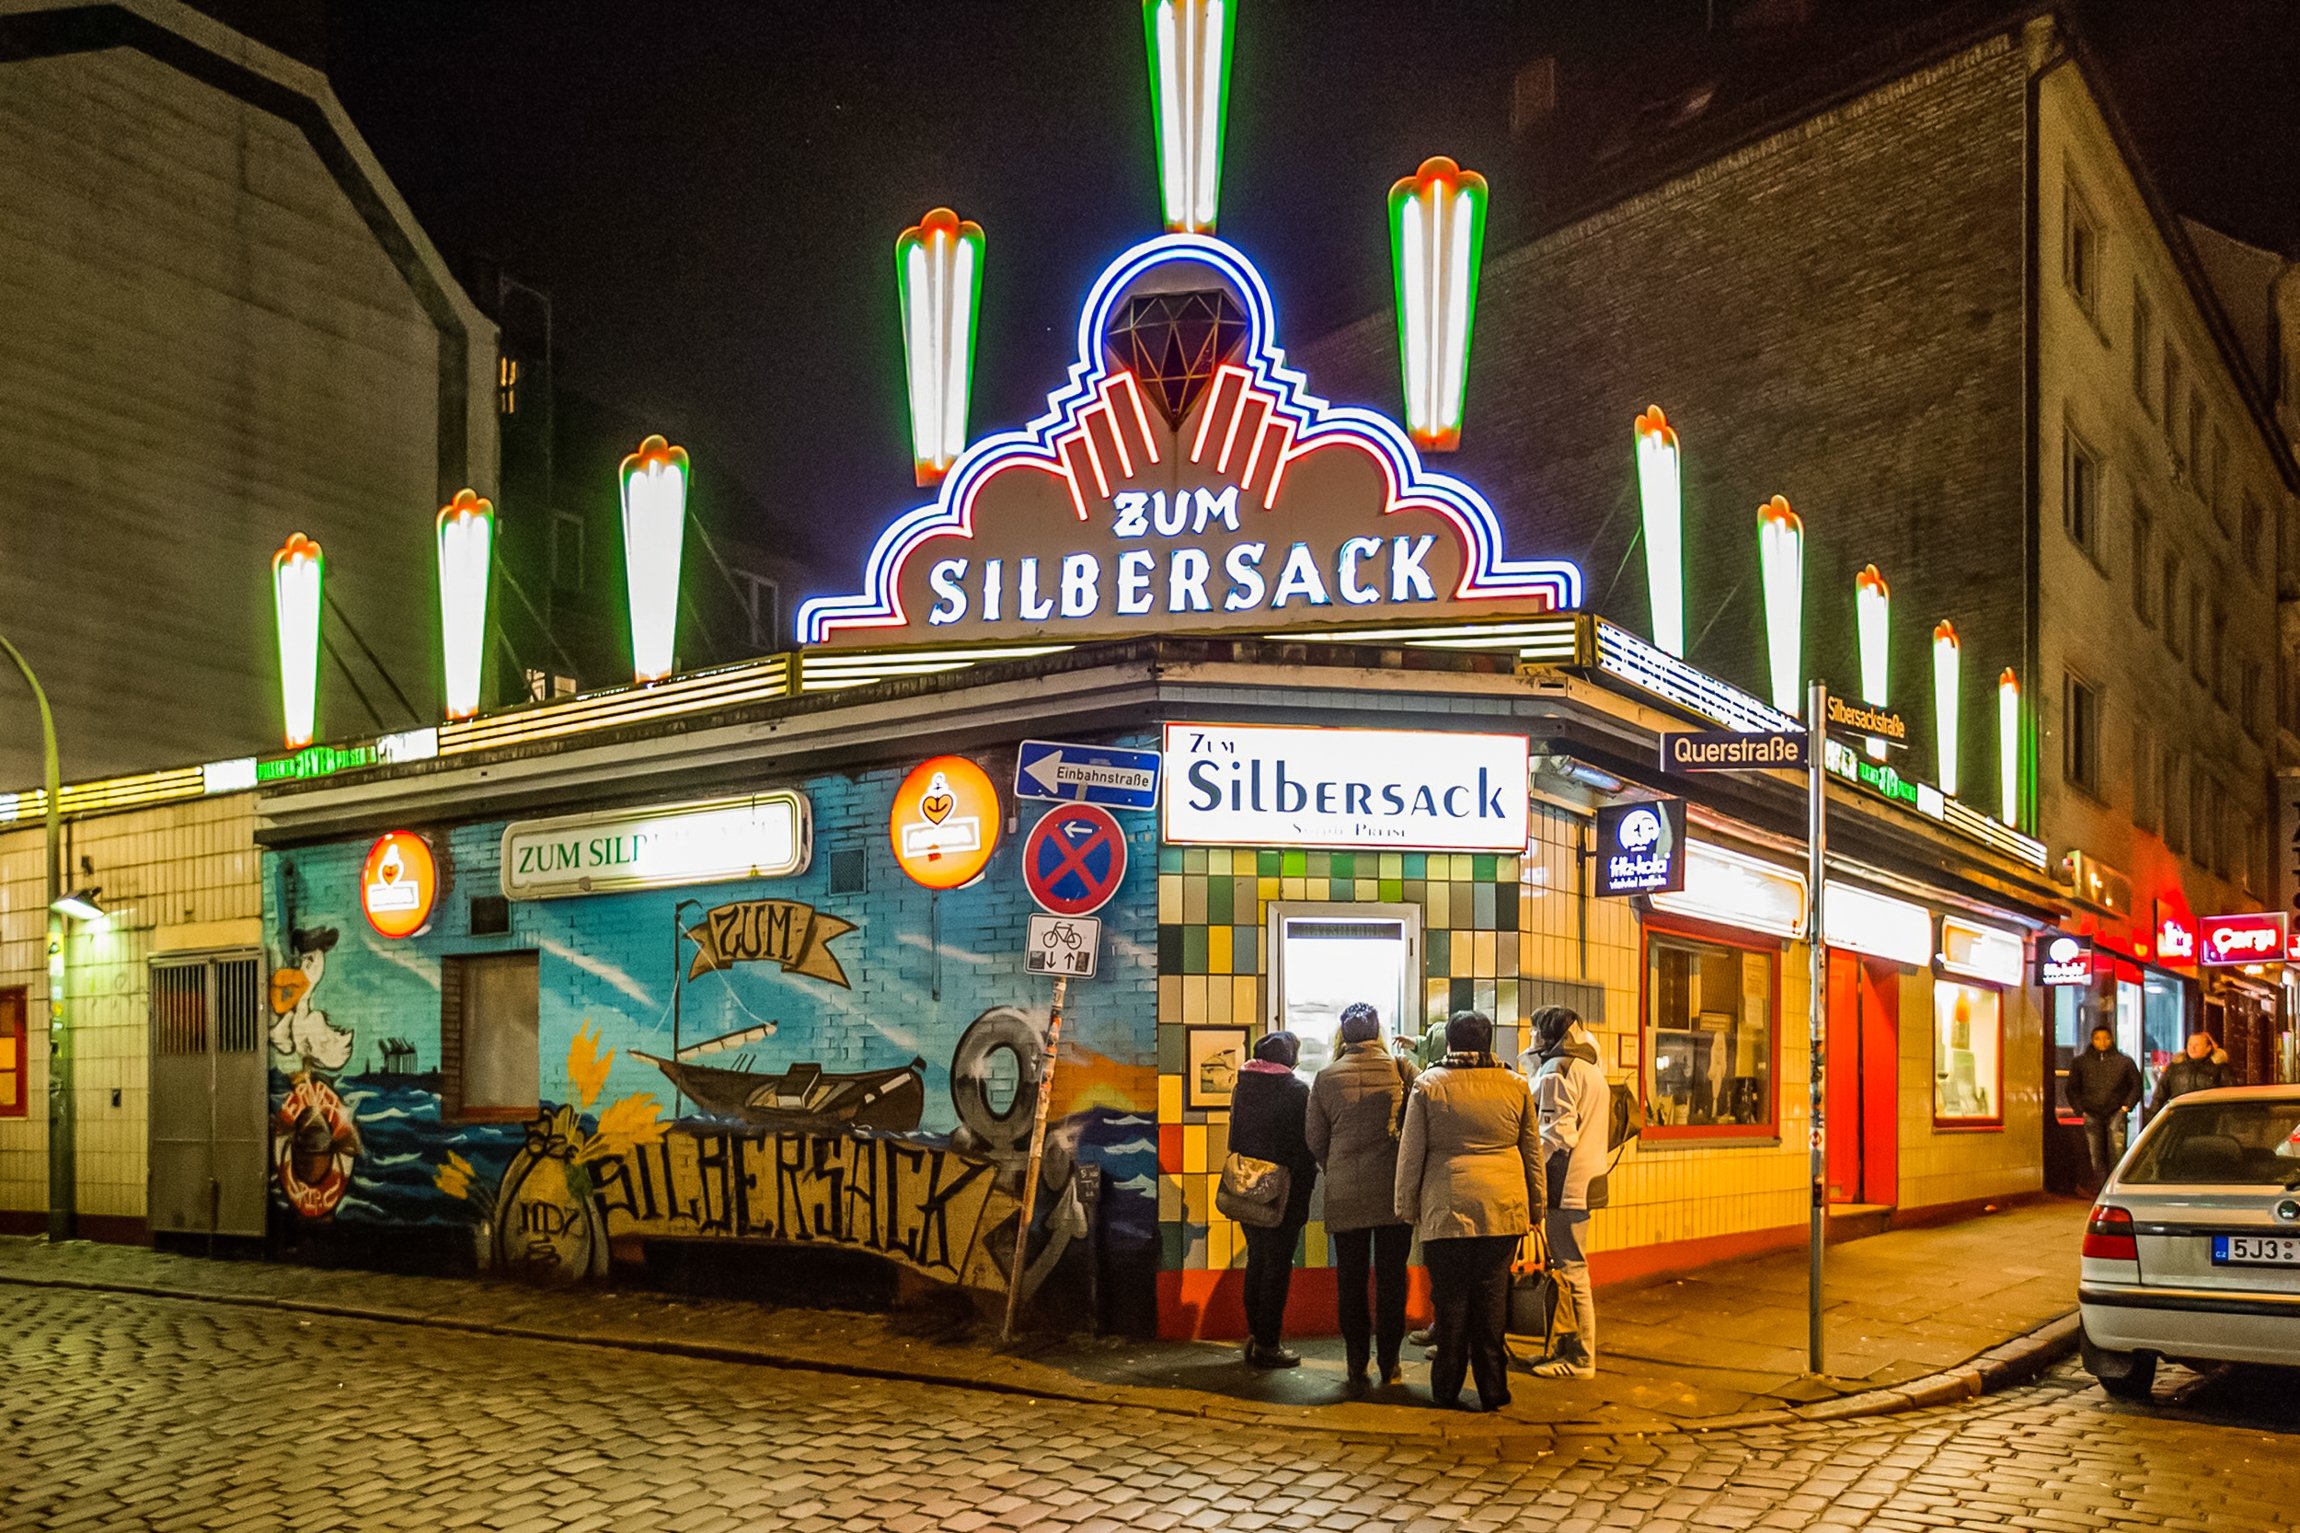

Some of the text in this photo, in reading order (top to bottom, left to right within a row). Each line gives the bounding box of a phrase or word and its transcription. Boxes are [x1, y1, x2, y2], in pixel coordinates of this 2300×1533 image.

[1112, 486, 1240, 538] ZUM
[928, 534, 1437, 626] SILBERSACK
[1827, 695, 1906, 739] Silbersackstraße
[1674, 736, 1799, 762] Querstraße
[1056, 766, 1150, 788] Einbahnstraße
[518, 840, 581, 875] ZUM
[713, 903, 795, 961] ZUM
[590, 1131, 996, 1275] SILBERSACK
[2215, 1250, 2227, 1258] CZ
[2233, 1238, 2278, 1259] 5J3
